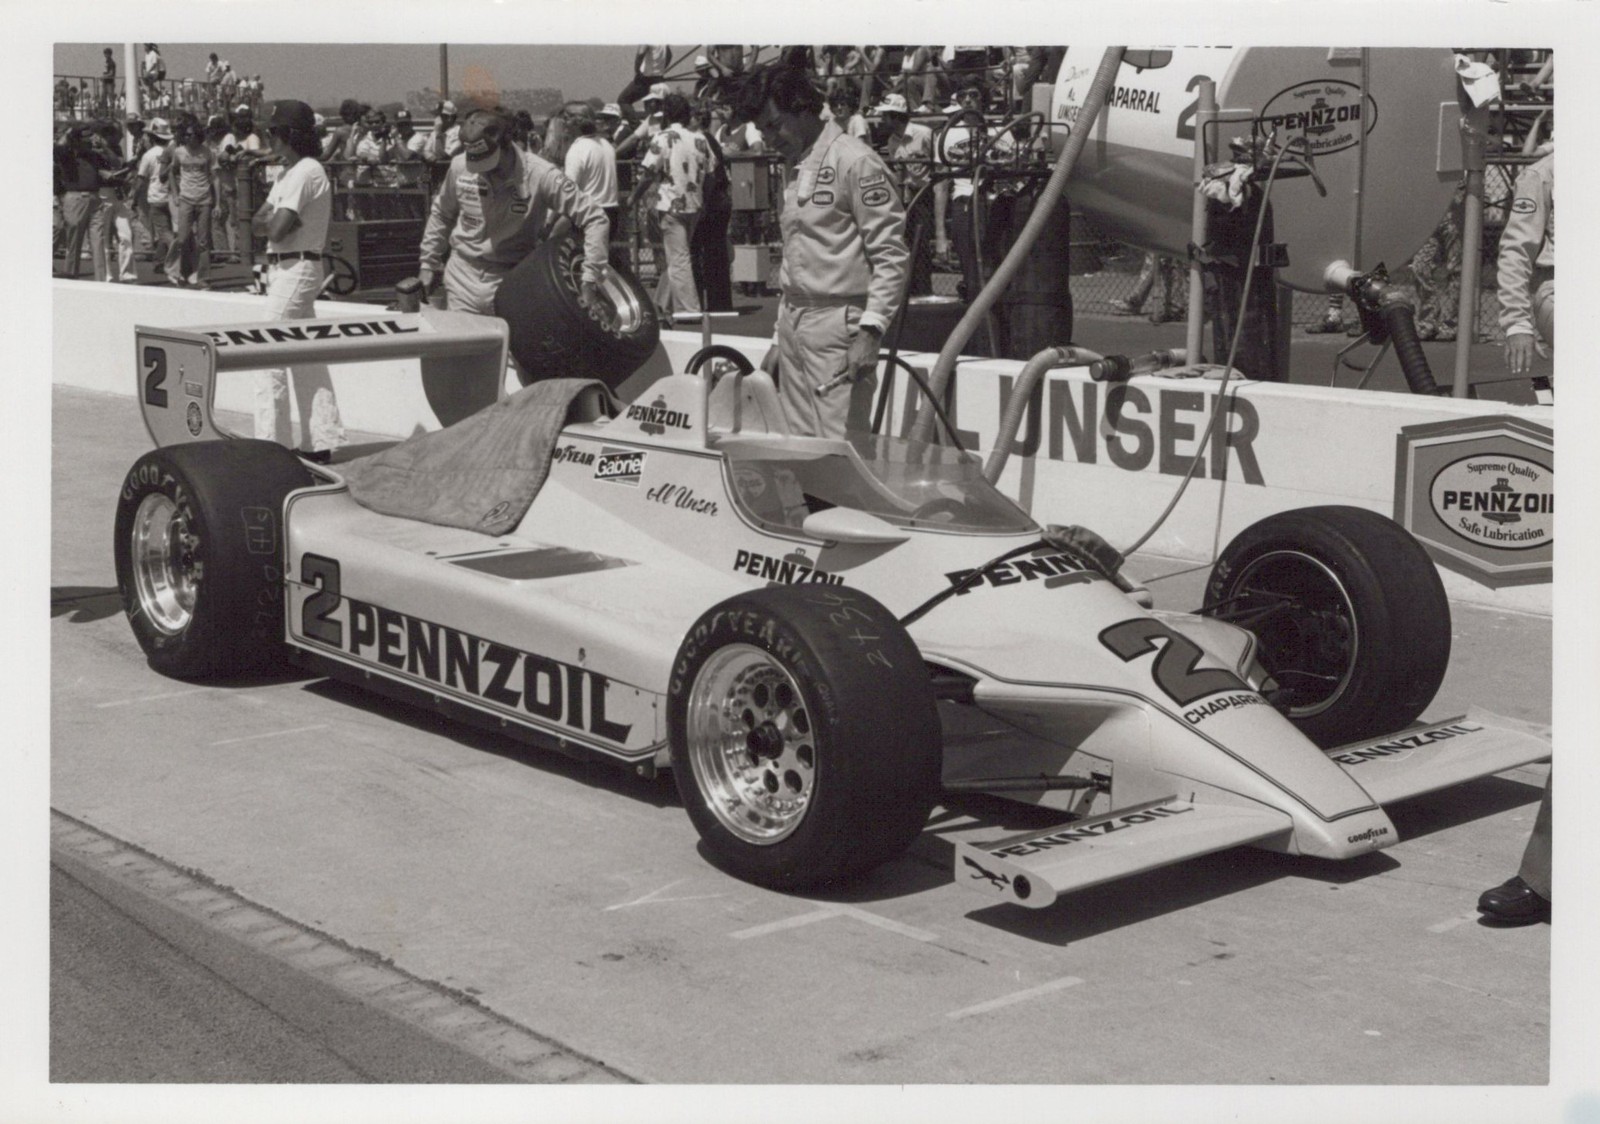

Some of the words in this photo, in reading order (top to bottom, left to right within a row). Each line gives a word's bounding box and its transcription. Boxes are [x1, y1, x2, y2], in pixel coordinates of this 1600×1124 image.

[1104, 86, 1160, 113] APARRAL
[202, 320, 418, 346] ENNZOIL
[144, 346, 168, 408] 2
[626, 404, 693, 430] PENNZOIL
[999, 374, 1266, 487] UNSER
[1466, 463, 1507, 475] Supreme
[1507, 462, 1540, 482] Quality
[1459, 516, 1482, 536] Safe
[1483, 525, 1545, 541] Lubrication
[301, 551, 343, 649] 2
[349, 598, 633, 745] PENNZOIL
[1098, 617, 1254, 708] 2
[1332, 725, 1484, 765] ENNZOIL
[1348, 827, 1388, 843] GOODYEAR
